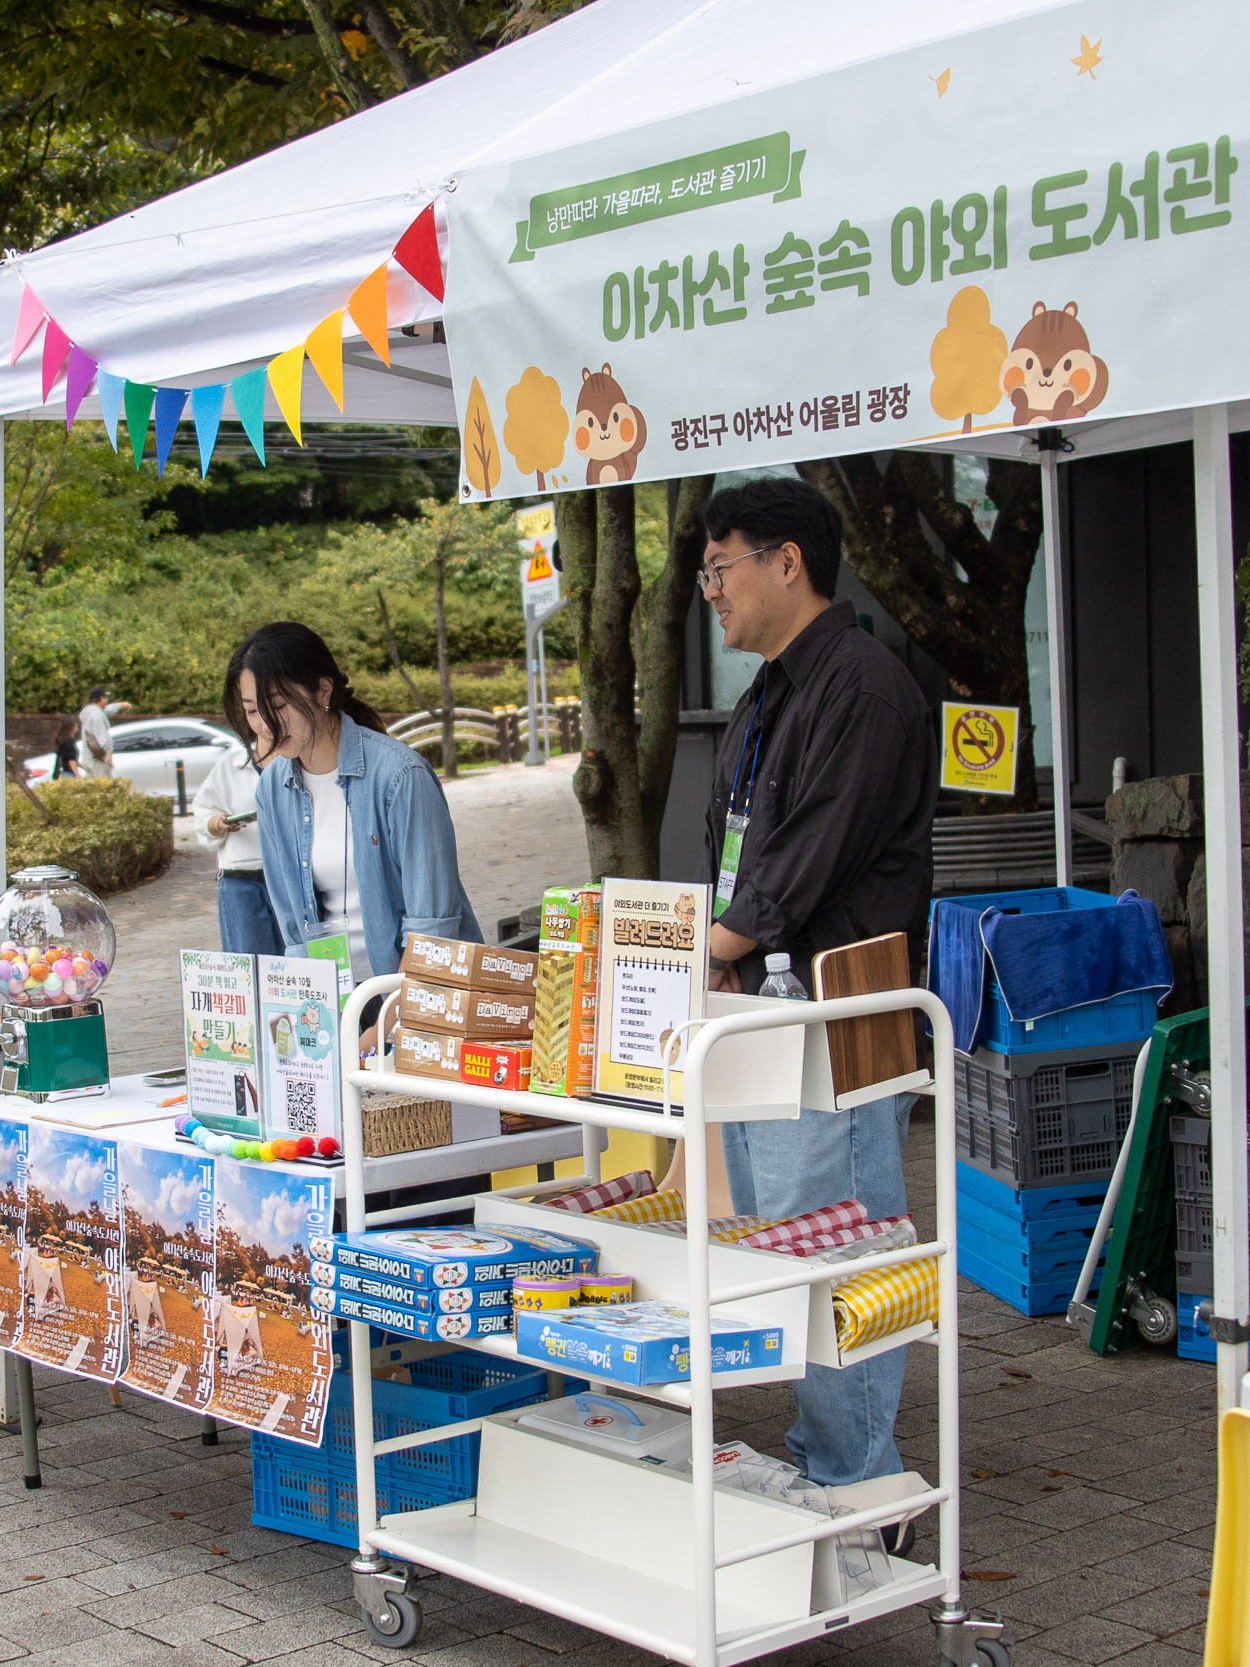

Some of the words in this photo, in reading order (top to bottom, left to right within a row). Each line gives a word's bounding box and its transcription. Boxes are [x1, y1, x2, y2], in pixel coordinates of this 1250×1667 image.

[546, 197, 598, 234] 낭만따라
[602, 183, 663, 216] 가을따라,
[667, 168, 716, 200] 도서관
[719, 155, 767, 192] 즐기기
[602, 243, 750, 342] 아차산
[763, 219, 872, 315] 숲속
[891, 184, 1008, 286] 야외
[1029, 134, 1238, 261] 도서관
[670, 413, 729, 452] 광진구
[733, 401, 794, 442] 아차산
[799, 390, 860, 432] 어울림
[866, 382, 911, 423] 광장
[614, 899, 643, 911] 야외도서관
[644, 901, 650, 911] 더
[651, 902, 669, 912] 즐기기
[614, 918, 694, 951] 빌려드려요
[481, 956, 534, 977] DaVinci
[197, 974, 214, 988] 30분
[215, 976, 222, 989] 책
[267, 973, 284, 986] 아차산
[285, 975, 297, 987] 숲속
[298, 976, 311, 988] 10월
[190, 990, 246, 1016] 자개책갈피
[267, 986, 280, 998] 야외
[280, 987, 297, 1000] 도서관
[298, 989, 328, 1002] 만족도조사
[476, 1002, 529, 1020] DaVinci
[203, 1018, 236, 1041] 만들기
[464, 1053, 491, 1068] HALLI
[464, 1065, 491, 1078] GALLI
[337, 1247, 360, 1267] 게임
[359, 1253, 411, 1280] 다이아몬드
[339, 1272, 362, 1292] 게임
[473, 1264, 505, 1282] 게임
[361, 1278, 415, 1306] 다이아몬드
[478, 1289, 508, 1308] 게임
[101, 1247, 121, 1375] 야외도서관
[339, 1297, 362, 1317] 게임
[361, 1303, 415, 1331] 다이아몬드
[477, 1315, 508, 1334] 게임
